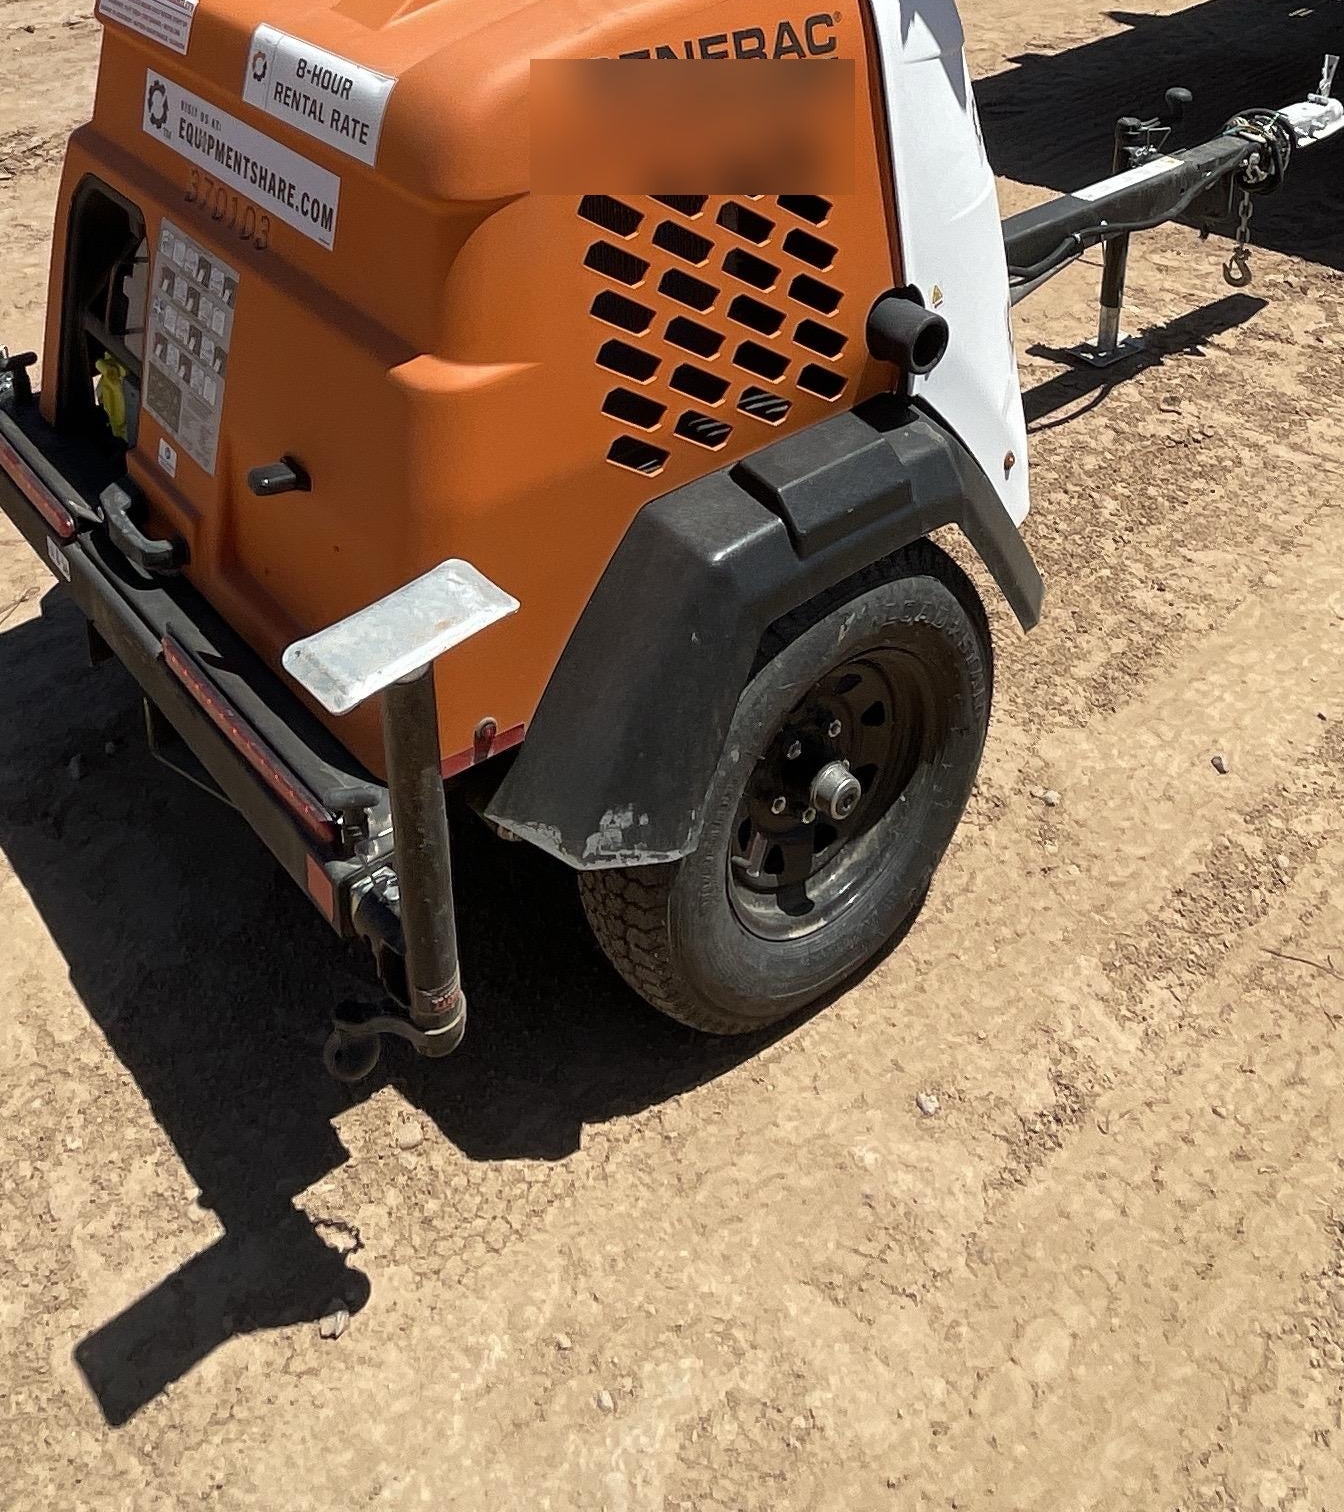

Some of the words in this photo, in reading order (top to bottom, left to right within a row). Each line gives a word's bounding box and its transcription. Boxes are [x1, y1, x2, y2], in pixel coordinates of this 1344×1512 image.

[296, 58, 354, 100] 8-HOUR
[274, 82, 325, 124] RENTAL
[330, 109, 370, 146] RATE
[178, 117, 334, 232] EQUIPMENTSHARE.COM
